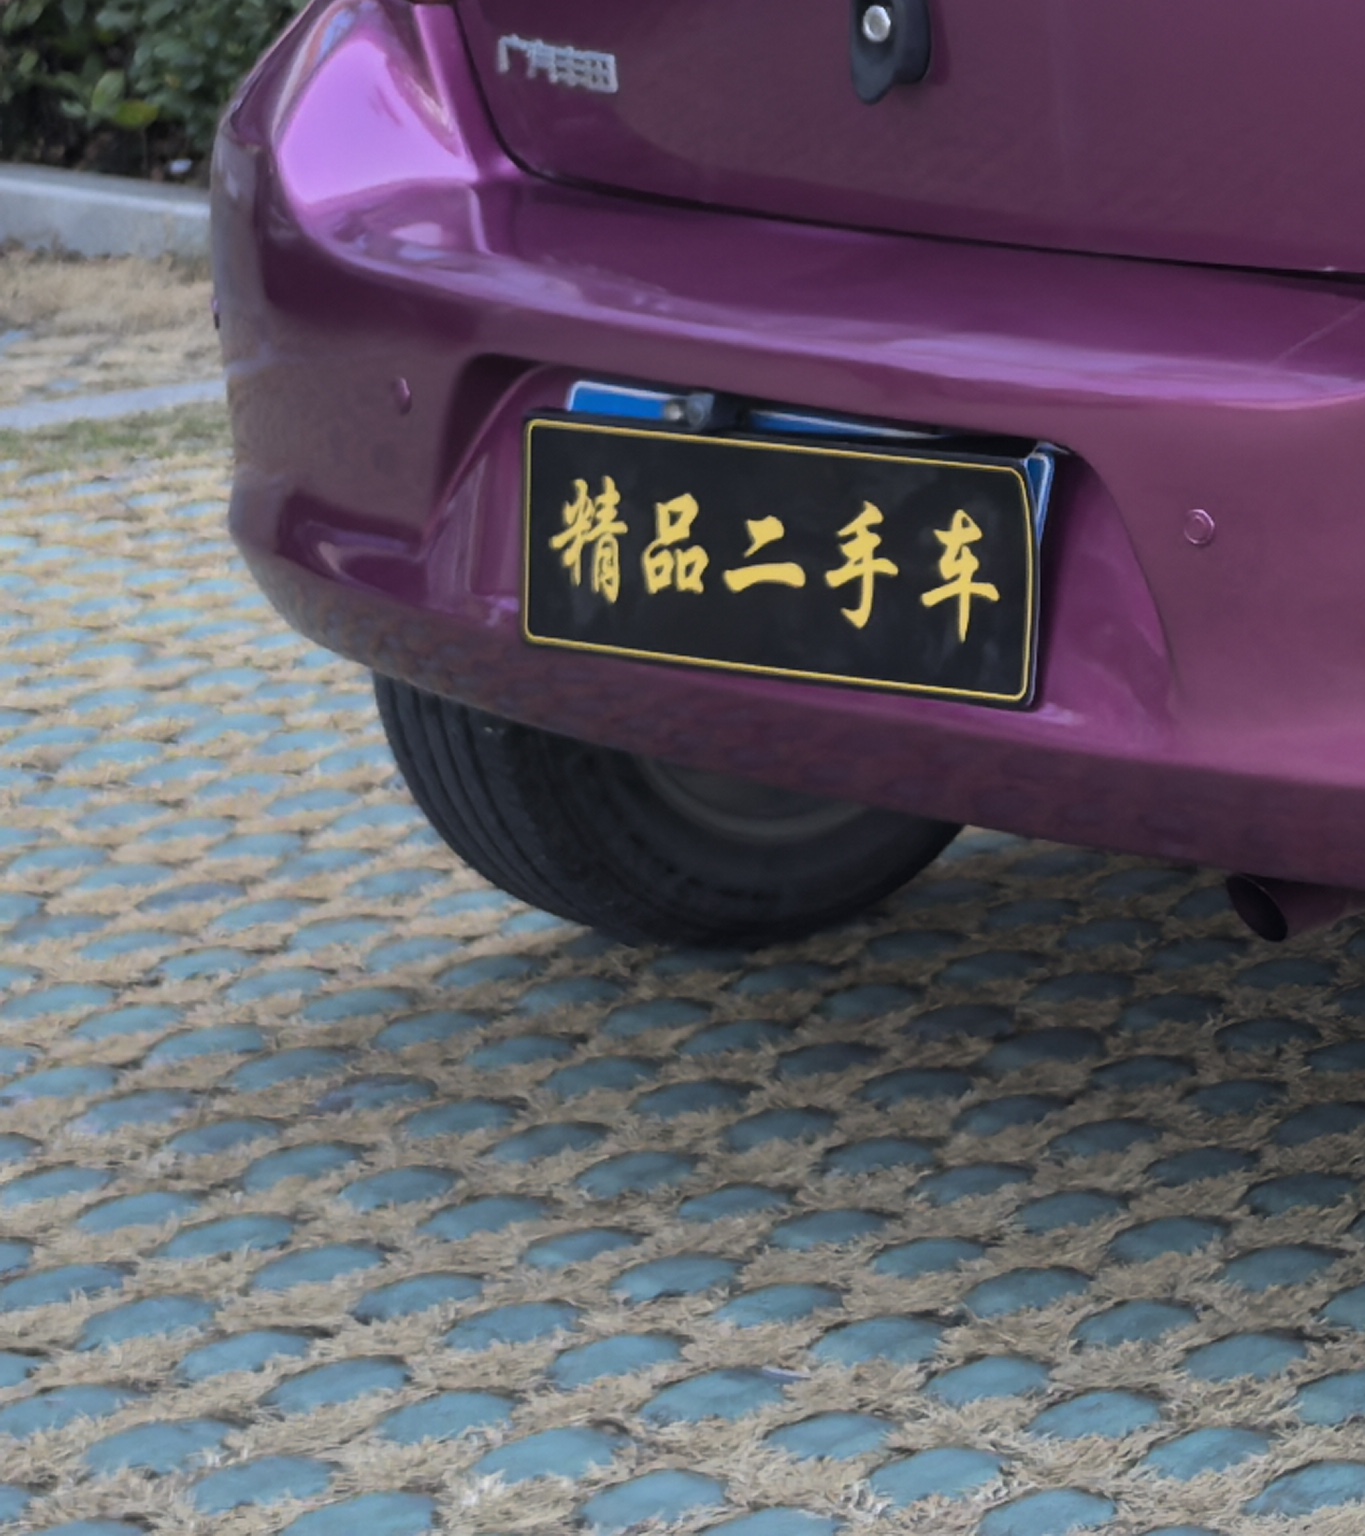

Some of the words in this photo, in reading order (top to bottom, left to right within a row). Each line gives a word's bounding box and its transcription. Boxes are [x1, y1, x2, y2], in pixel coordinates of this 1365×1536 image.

[549, 474, 1000, 642] 精品二手车
